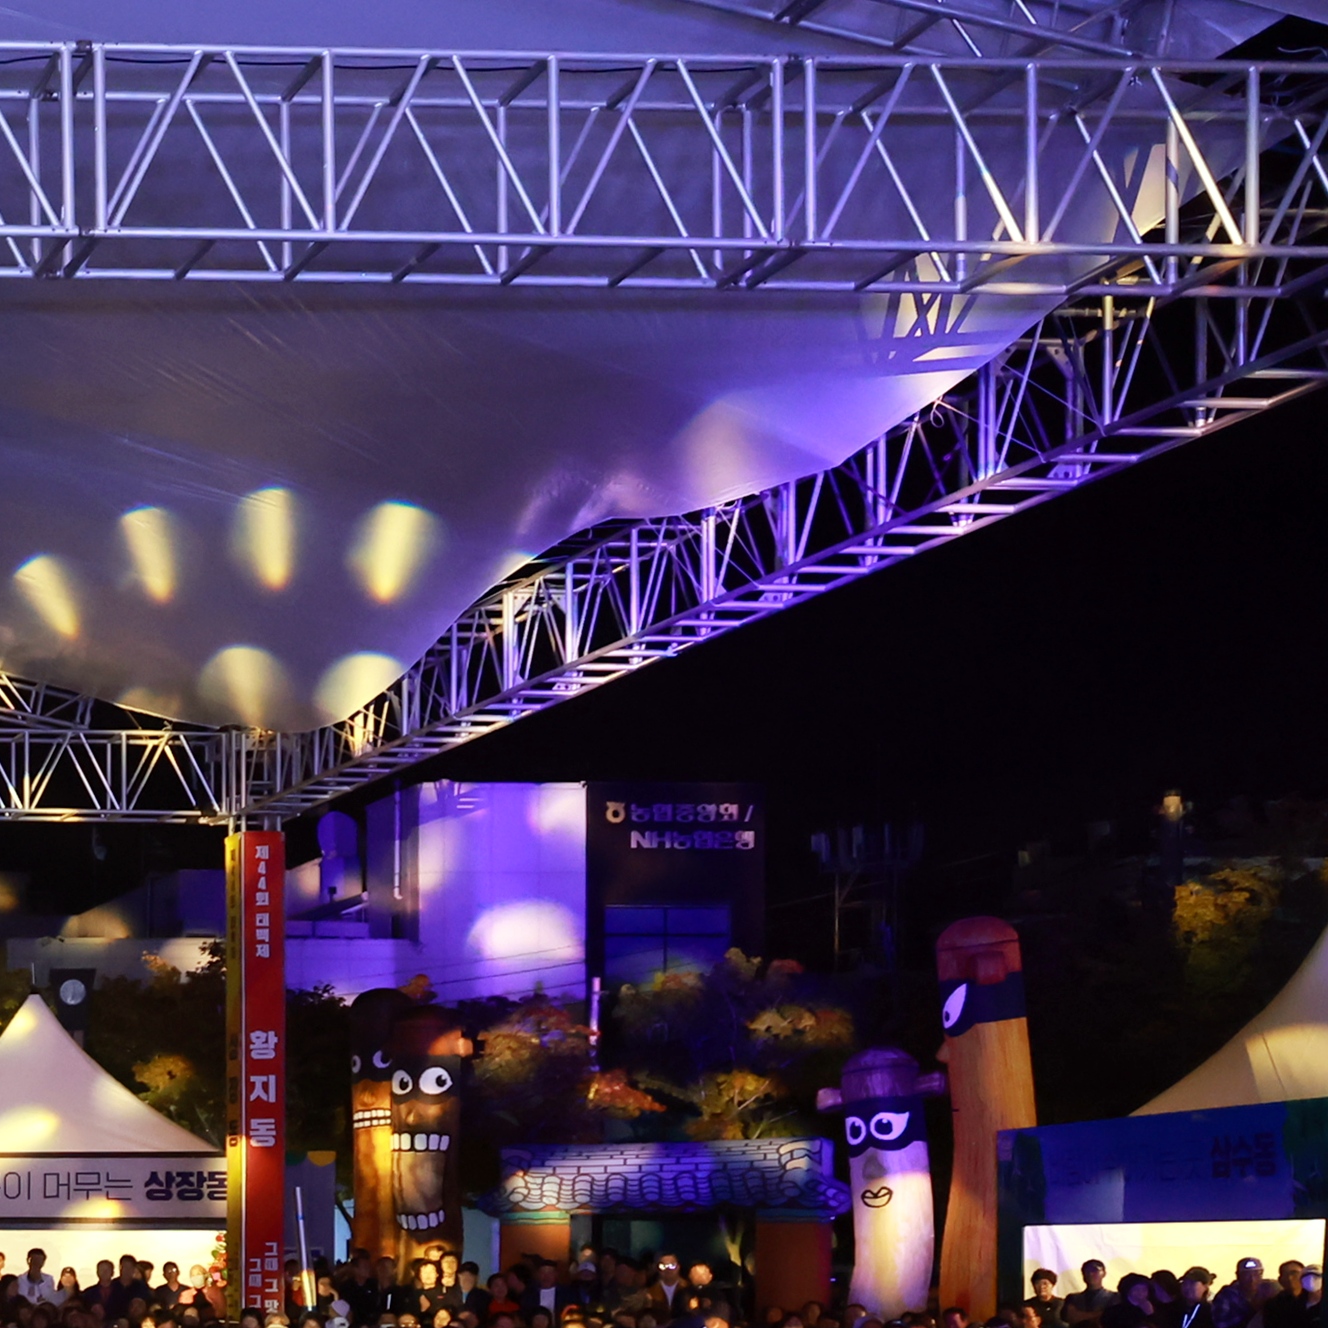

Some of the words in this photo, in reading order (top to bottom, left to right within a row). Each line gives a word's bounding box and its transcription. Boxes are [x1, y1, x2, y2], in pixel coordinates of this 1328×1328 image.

[630, 830, 755, 850] NH농협은행
[249, 1030, 278, 1147] 황지동
[43, 1171, 133, 1200] 머무는
[144, 1171, 228, 1201] 상장동
